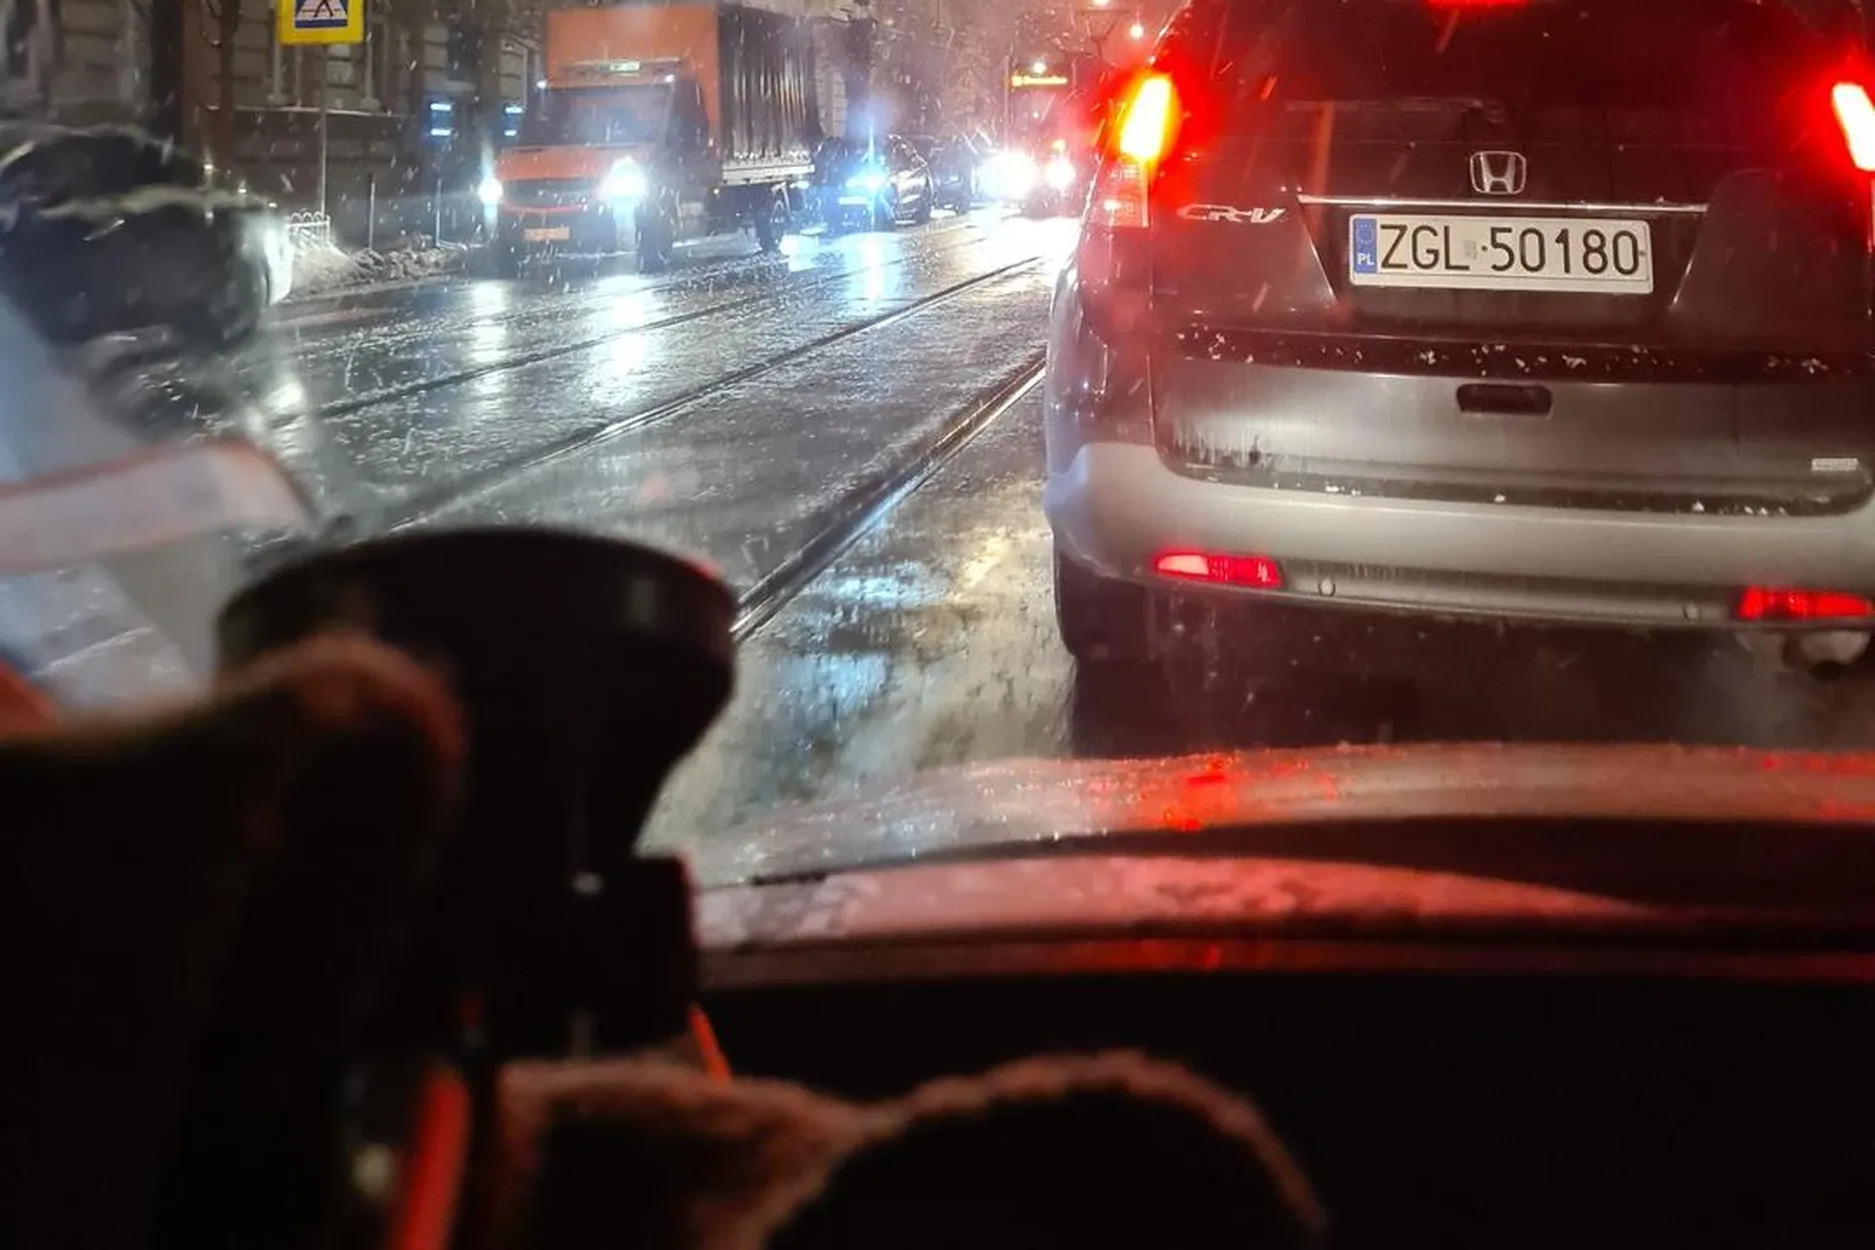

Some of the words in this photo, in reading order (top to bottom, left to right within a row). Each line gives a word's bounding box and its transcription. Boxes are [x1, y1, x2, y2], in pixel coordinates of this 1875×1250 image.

[1176, 203, 1286, 224] CR-V
[1357, 252, 1375, 266] PL
[1380, 224, 1470, 271] ZGL
[1490, 226, 1640, 276] 50180
